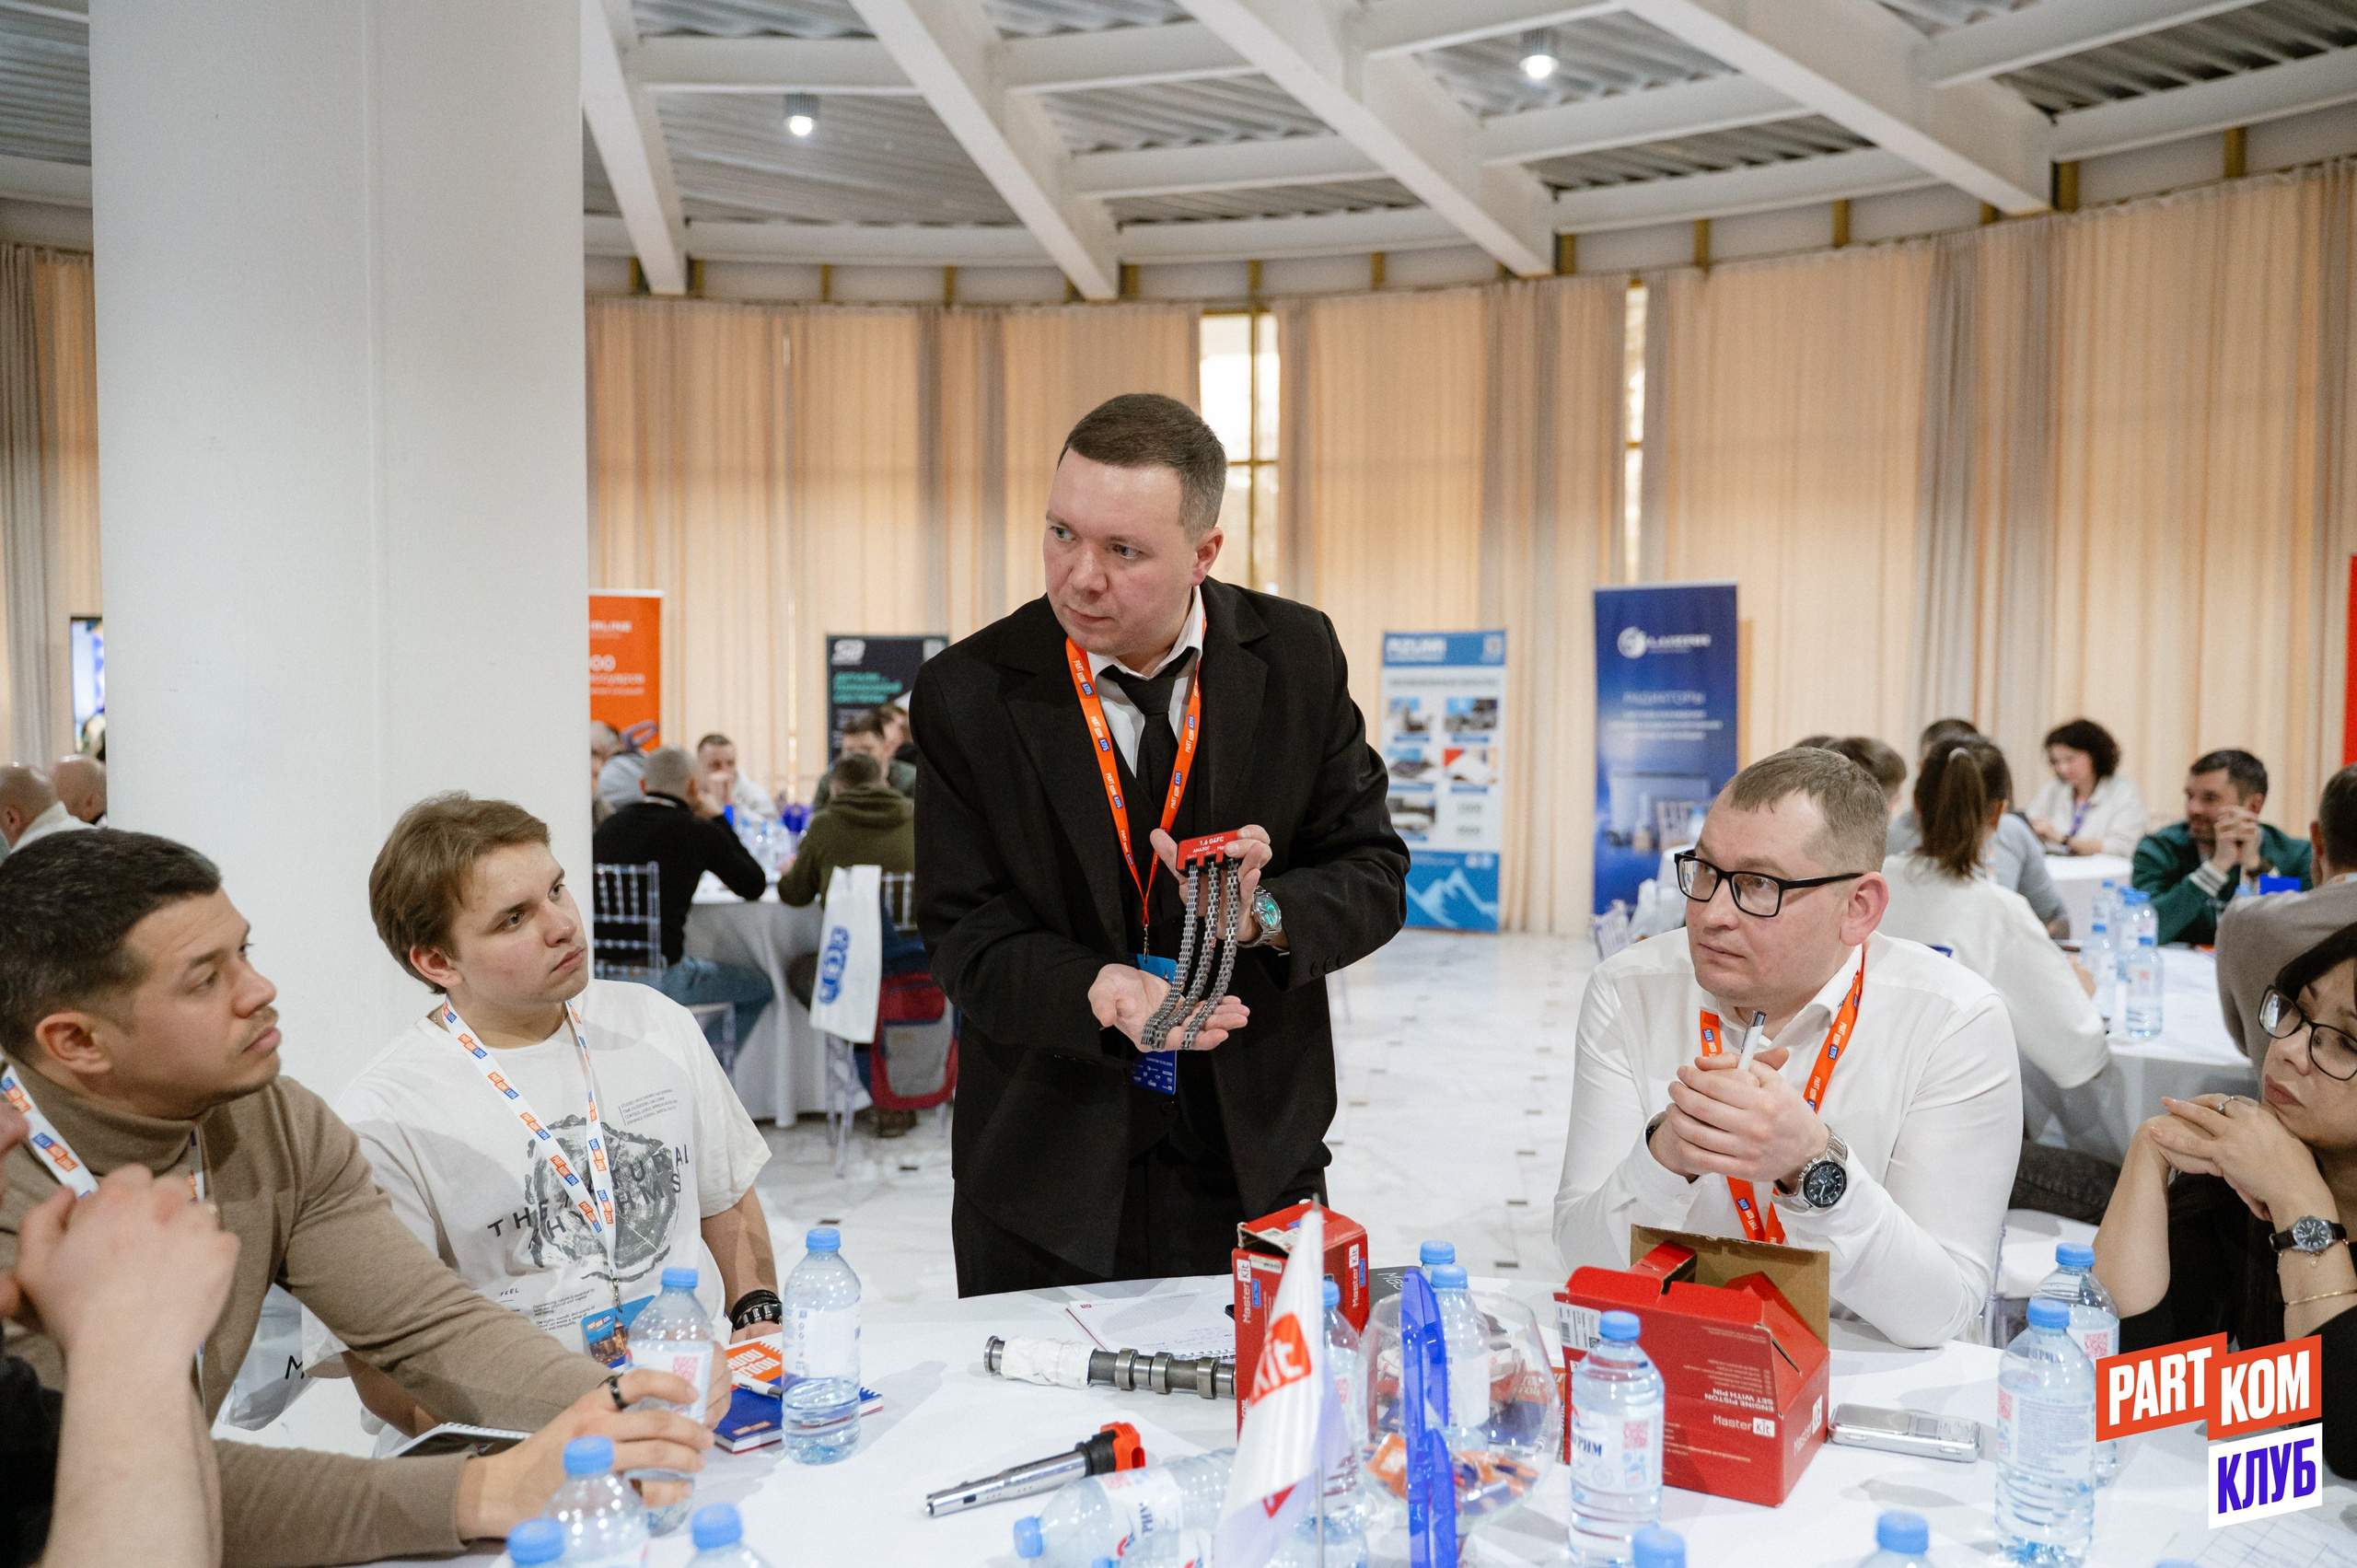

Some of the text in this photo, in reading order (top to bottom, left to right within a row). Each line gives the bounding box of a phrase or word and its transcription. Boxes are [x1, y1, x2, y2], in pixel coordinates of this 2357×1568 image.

[1838, 1022, 1847, 1036] PART
[487, 1199, 549, 1237] THE
[500, 1288, 519, 1296] FEEL
[284, 1355, 305, 1379] M
[1704, 1393, 1774, 1412] ENGINE PISTON
[1713, 1388, 1773, 1405] SET WITH PIN
